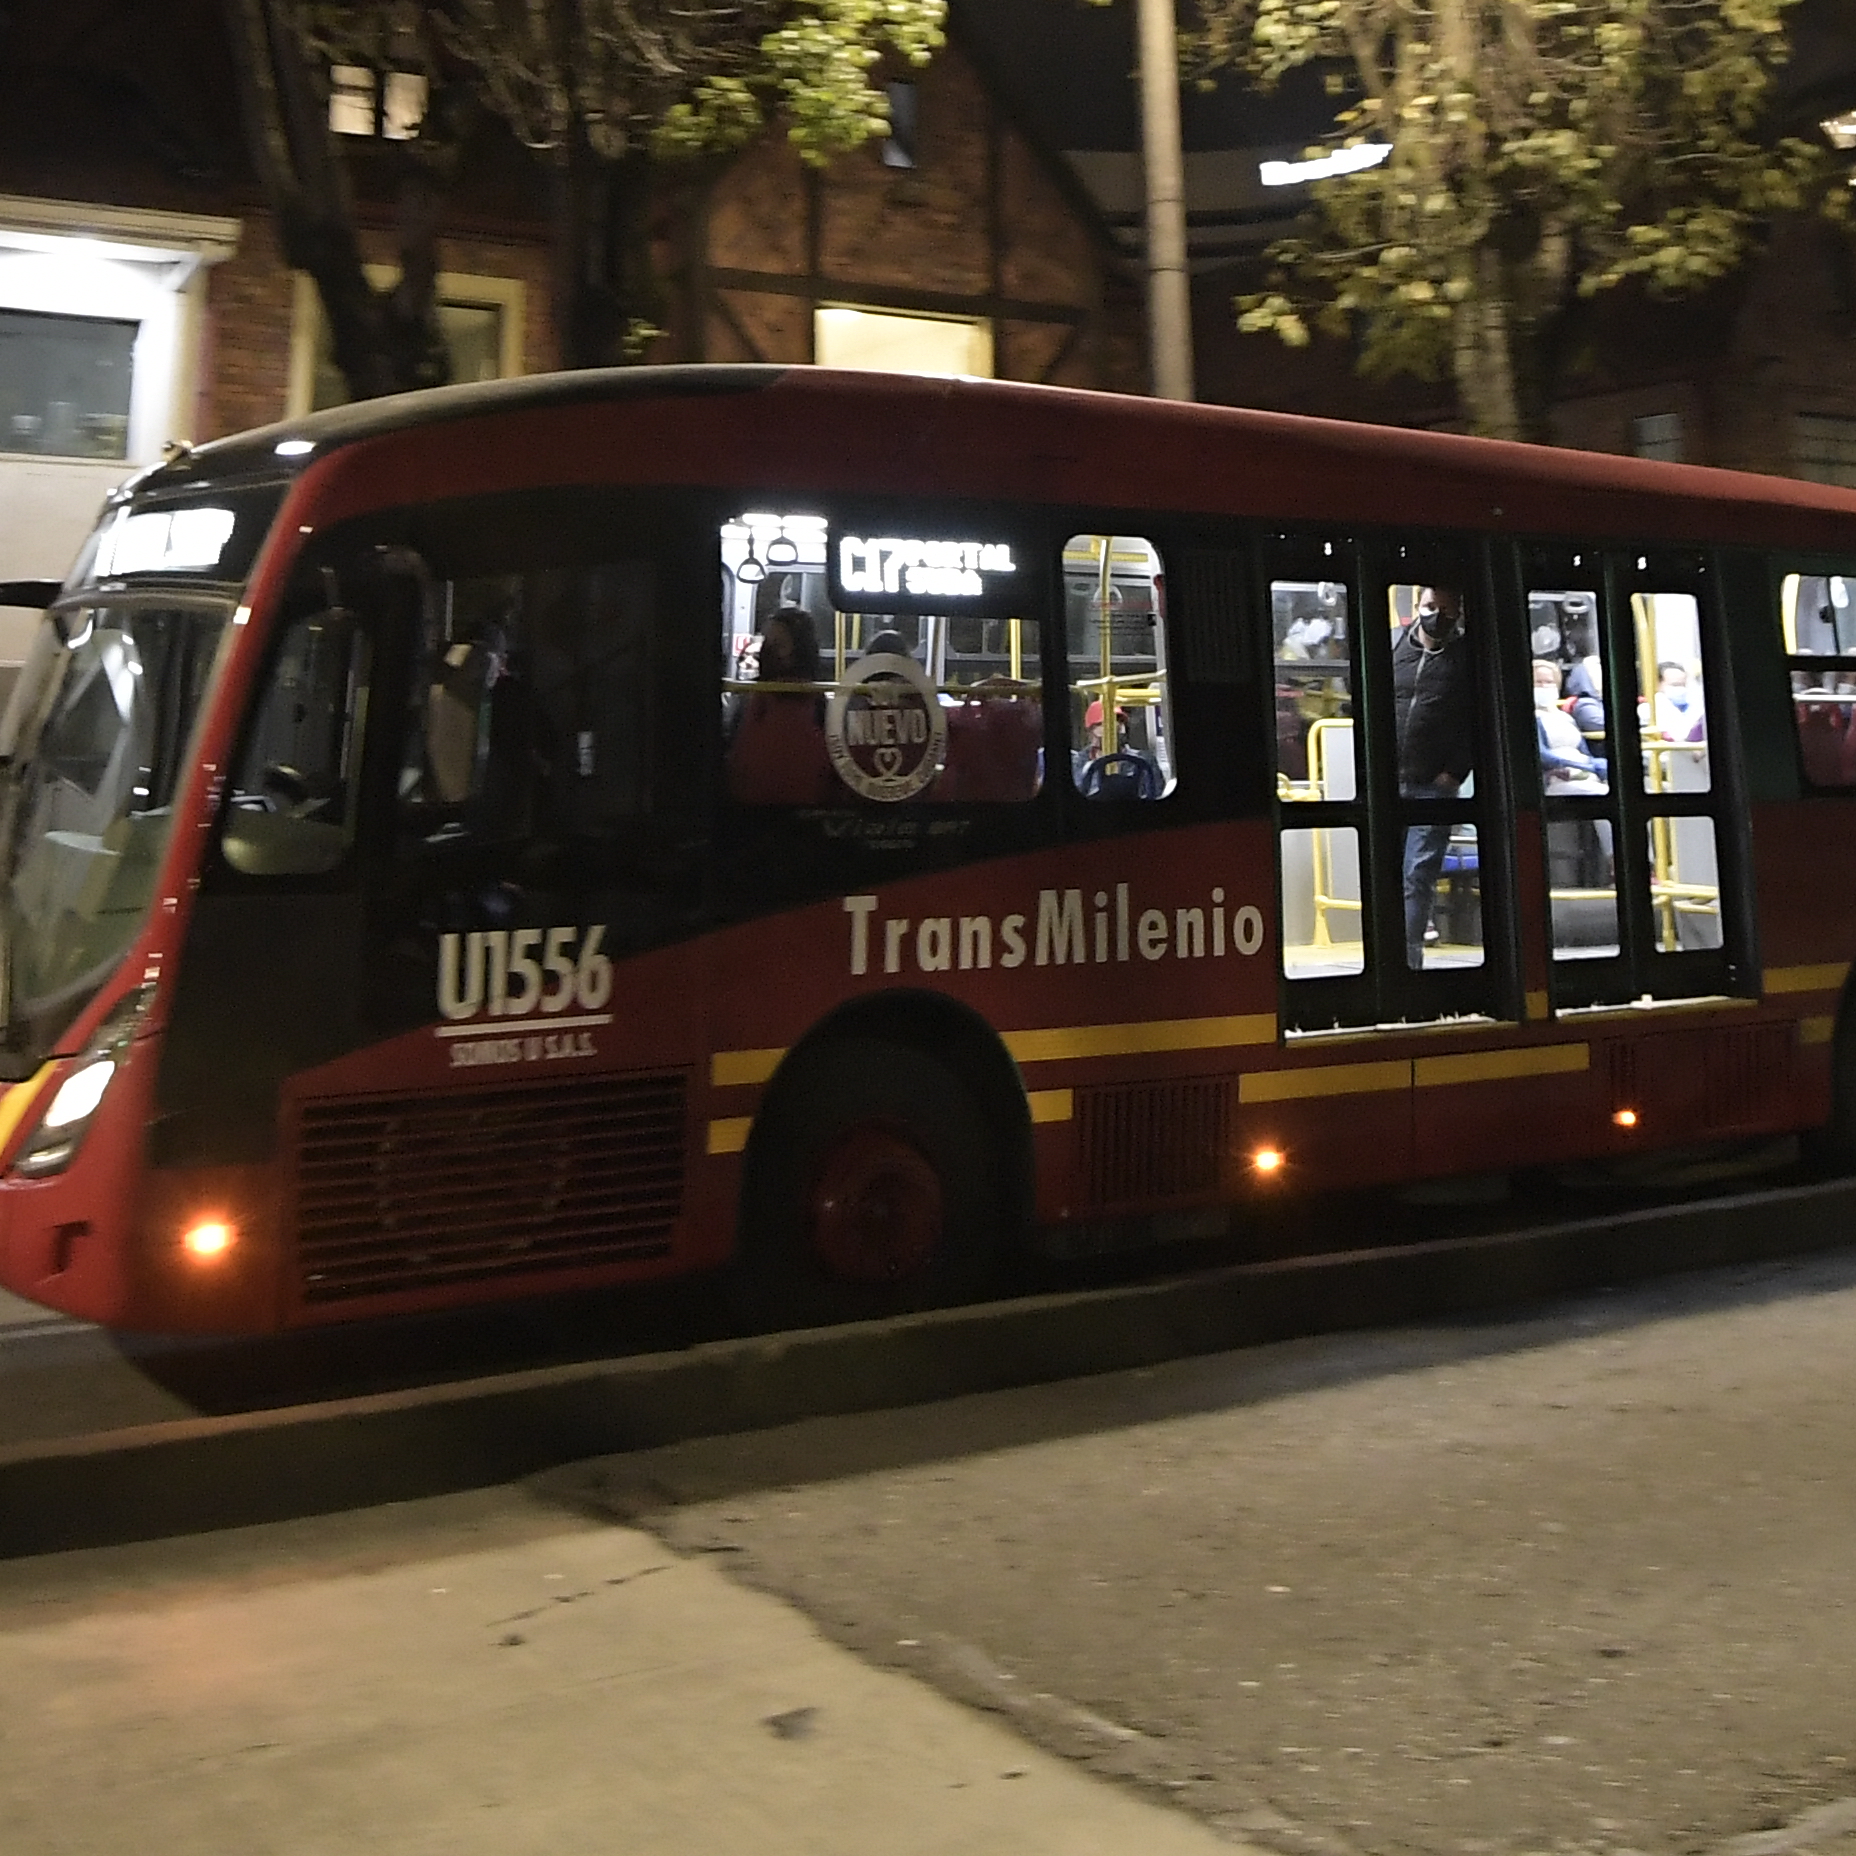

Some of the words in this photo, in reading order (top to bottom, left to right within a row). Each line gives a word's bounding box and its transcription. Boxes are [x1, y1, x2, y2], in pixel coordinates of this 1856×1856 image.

[847, 709, 928, 746] NUEVO
[437, 924, 614, 1021] U1556
[844, 883, 1264, 975] TransMilenio
